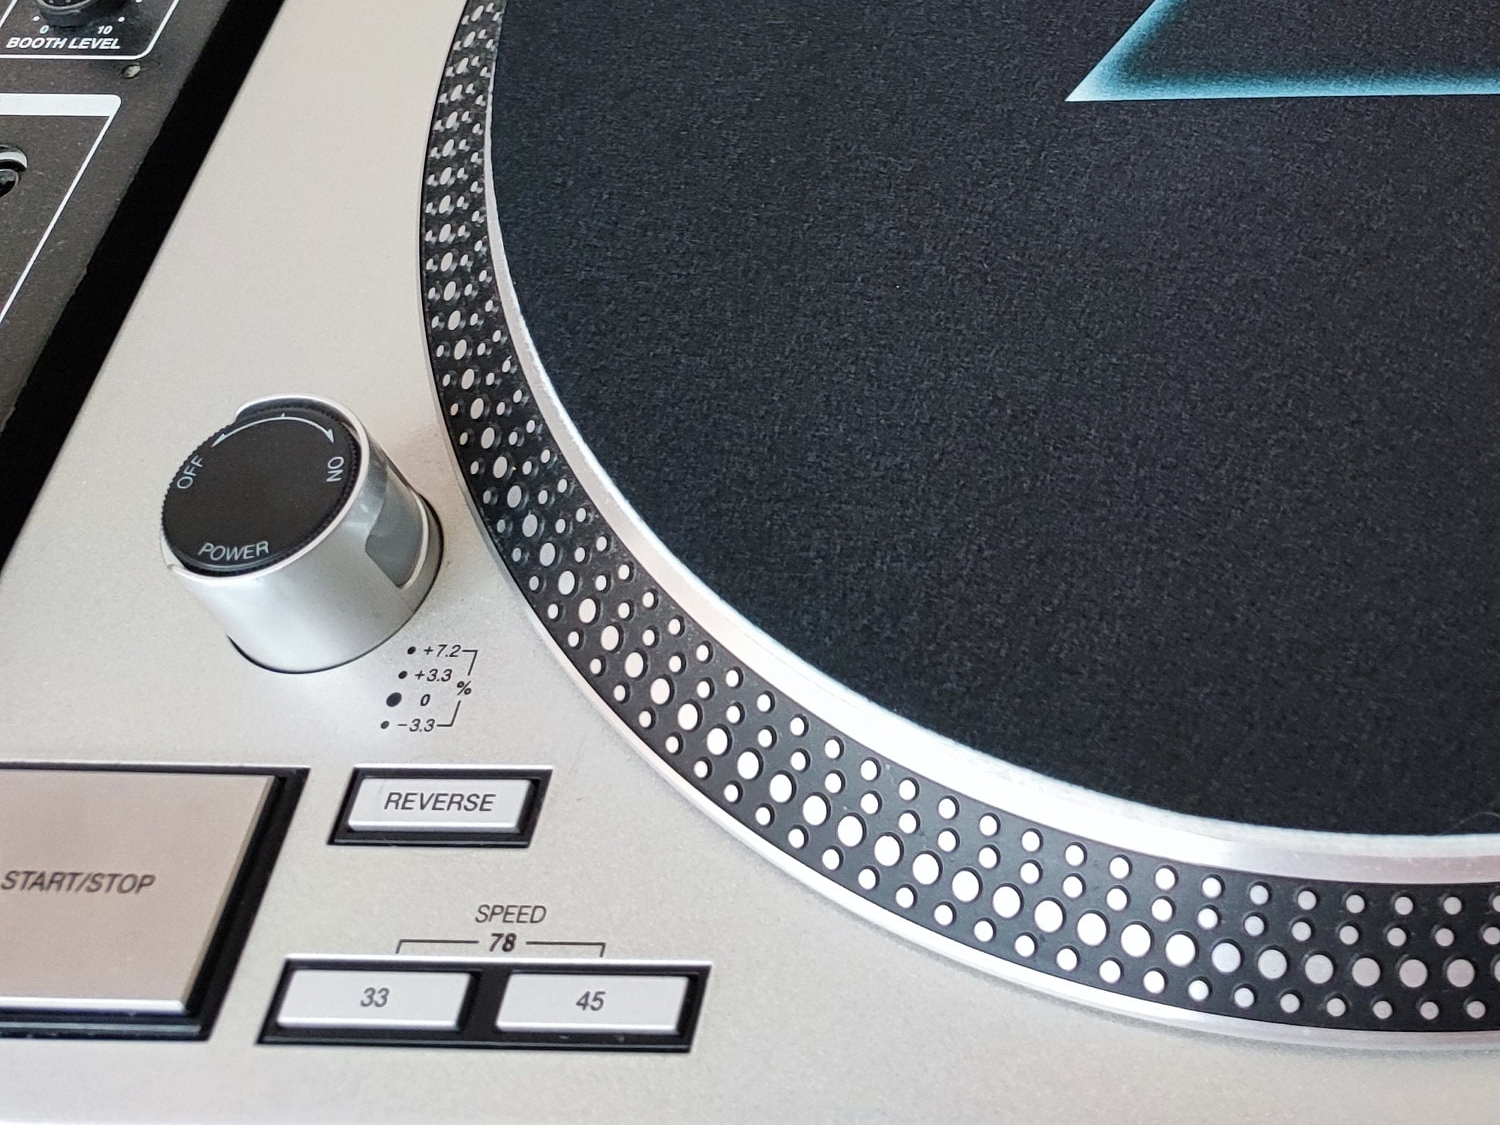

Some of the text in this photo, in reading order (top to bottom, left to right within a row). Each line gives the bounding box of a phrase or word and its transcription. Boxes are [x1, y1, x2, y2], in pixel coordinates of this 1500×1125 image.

[39, 25, 113, 35] 0 10
[6, 37, 121, 50] BOOTH LEVEL
[176, 455, 345, 489] OFF ON
[198, 540, 269, 562] POWER
[423, 644, 462, 658] +7.2
[414, 668, 453, 682] +3.3
[456, 680, 472, 696] %
[420, 693, 431, 707] 0
[397, 718, 436, 732] -3.3
[384, 791, 497, 812] REVERSE
[0, 869, 157, 895] START/STOP
[475, 904, 547, 924] SPEED
[489, 932, 517, 953] 78
[360, 987, 606, 1012] 33 45
